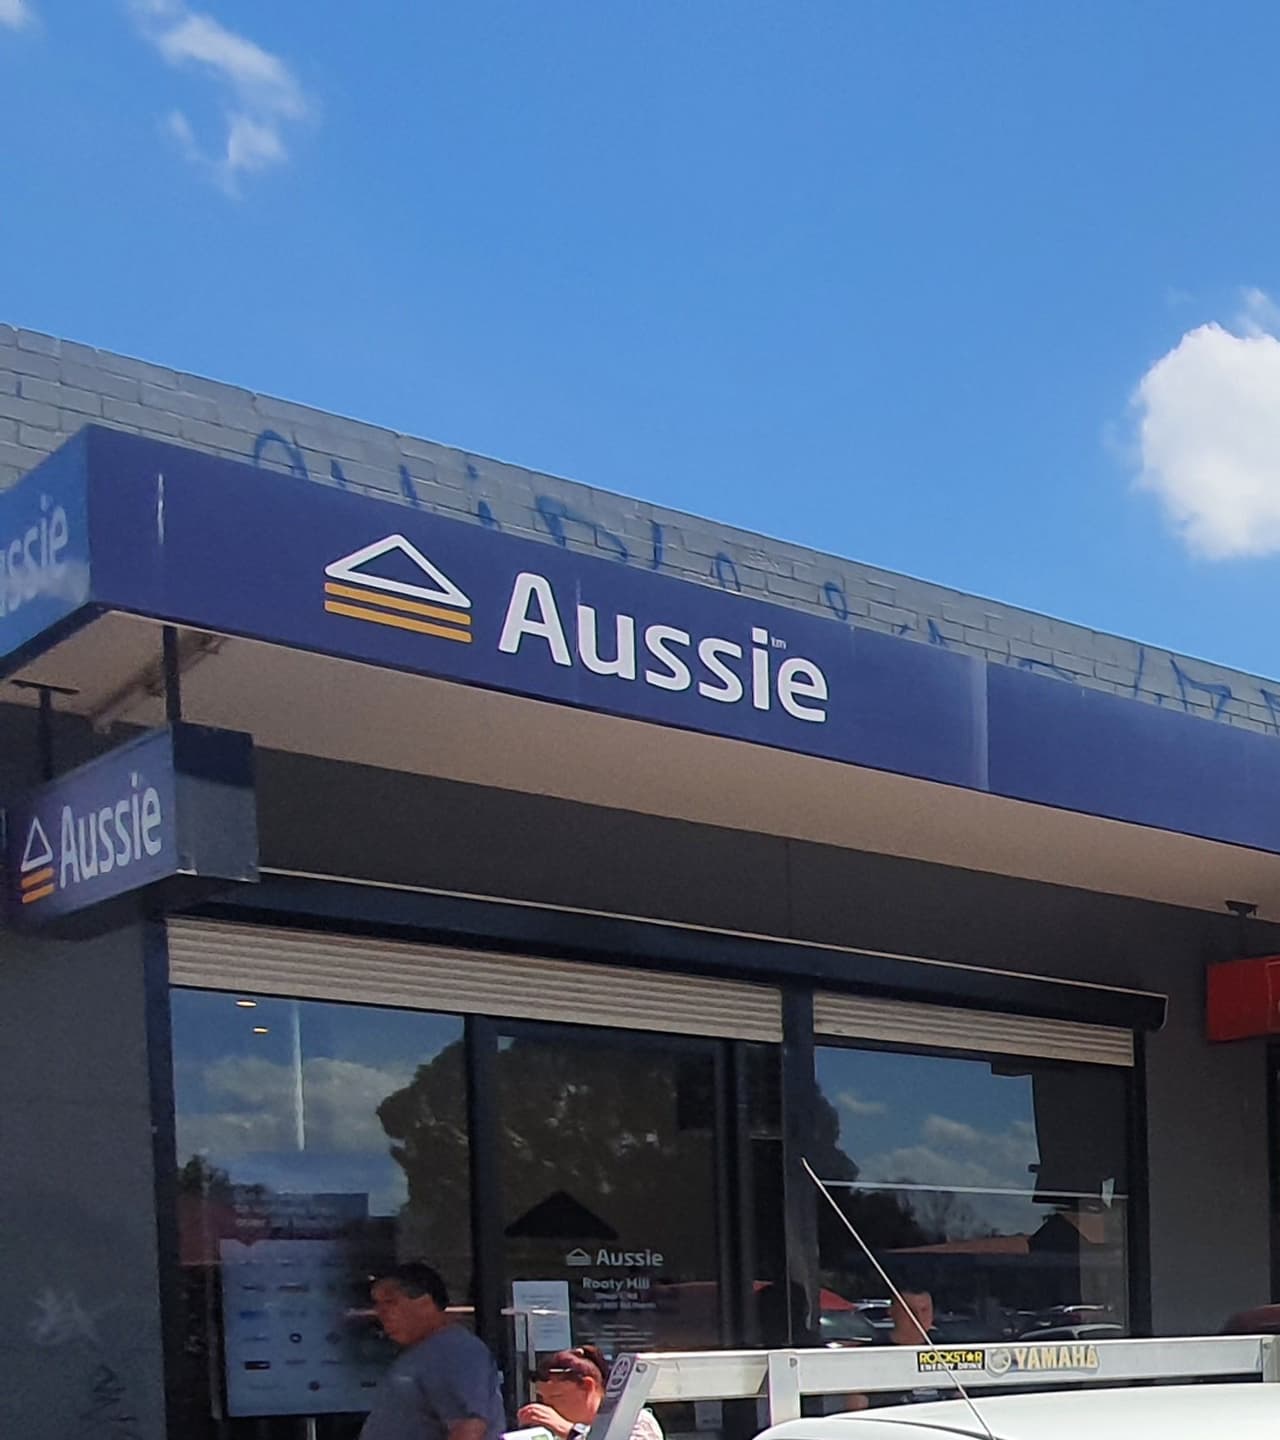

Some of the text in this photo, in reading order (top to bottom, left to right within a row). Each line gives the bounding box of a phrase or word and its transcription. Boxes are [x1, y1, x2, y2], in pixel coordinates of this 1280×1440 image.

[0, 493, 69, 617] ssie
[498, 571, 828, 723] Aussie
[59, 771, 162, 889] Aussie
[583, 1277, 623, 1292] Rooty
[597, 1248, 665, 1267] Aussie
[1014, 1345, 1098, 1370] YAMAHA
